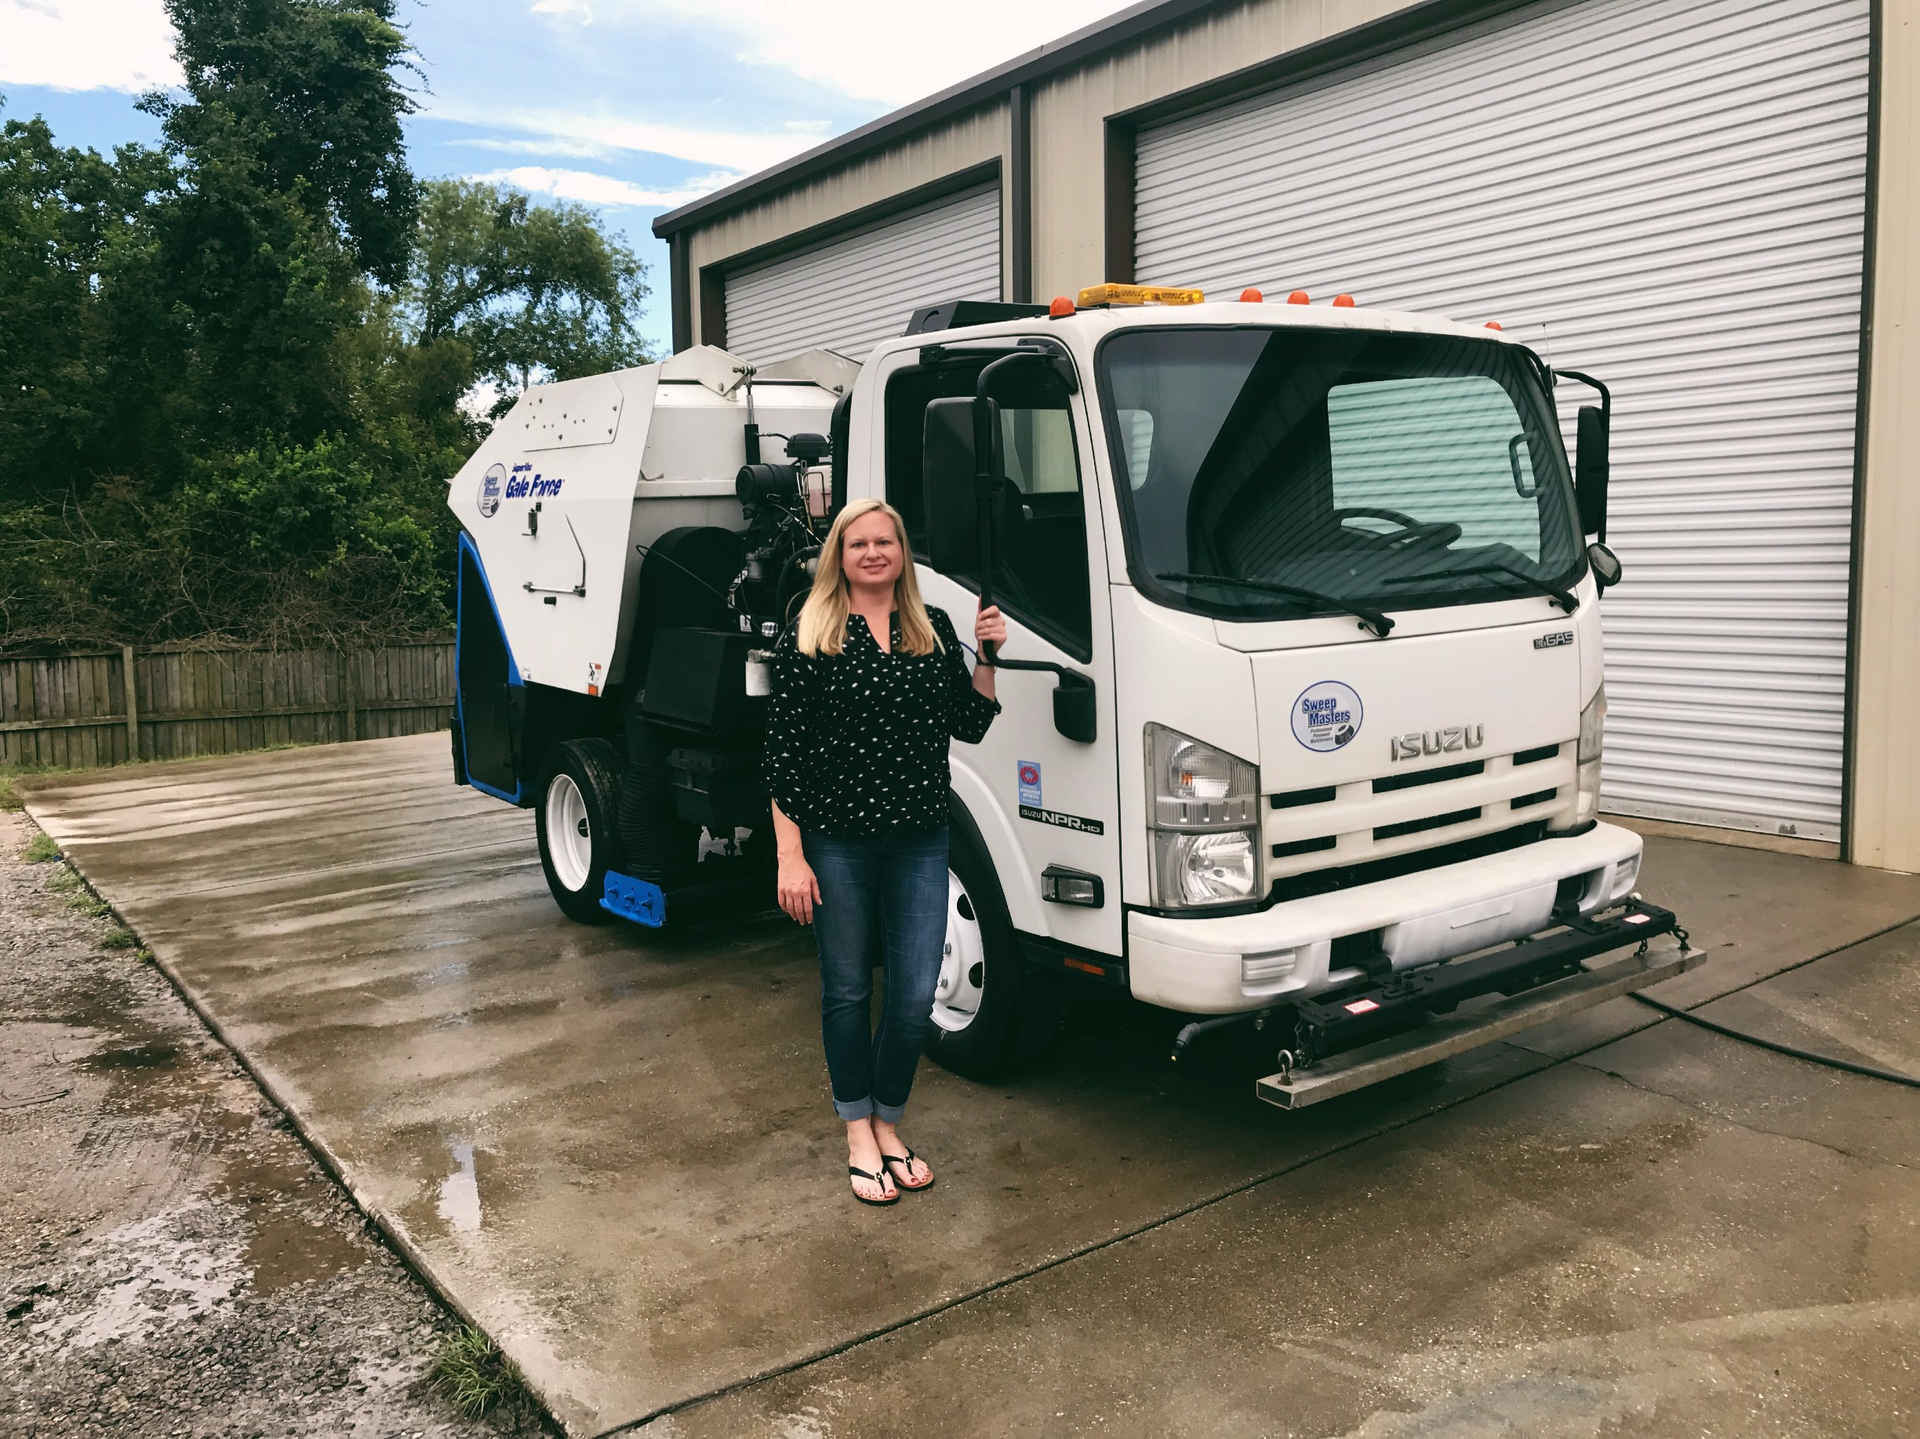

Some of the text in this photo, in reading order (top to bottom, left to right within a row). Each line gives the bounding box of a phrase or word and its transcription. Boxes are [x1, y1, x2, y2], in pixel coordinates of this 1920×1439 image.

[505, 474, 562, 498] Gale Force
[1545, 632, 1573, 646] GAS
[1303, 698, 1337, 713] Sweep
[1308, 710, 1351, 727] Masters
[1391, 723, 1484, 762] ISUZU
[1021, 809, 1100, 833] ISUZU NPR HD
